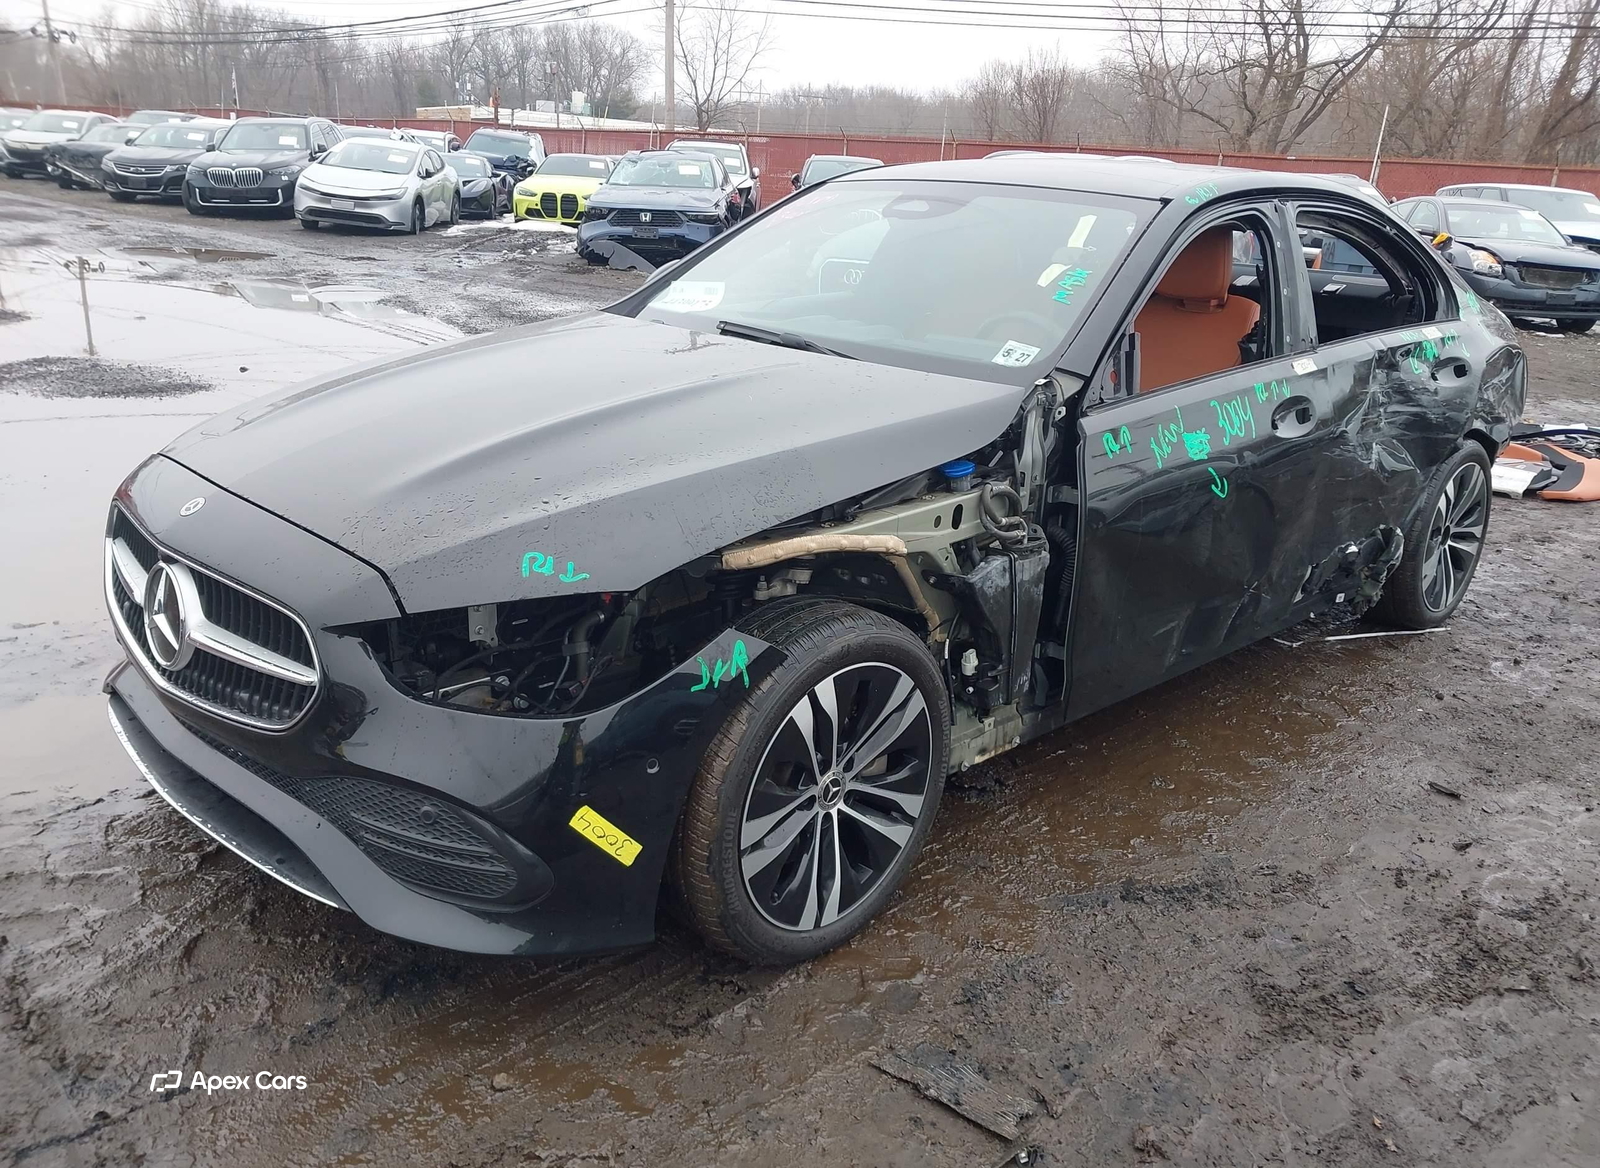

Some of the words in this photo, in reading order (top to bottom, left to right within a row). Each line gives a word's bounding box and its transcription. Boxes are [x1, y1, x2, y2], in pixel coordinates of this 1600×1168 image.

[1002, 348, 1013, 358] 5
[1015, 352, 1031, 363] 27
[577, 810, 632, 857] 3004
